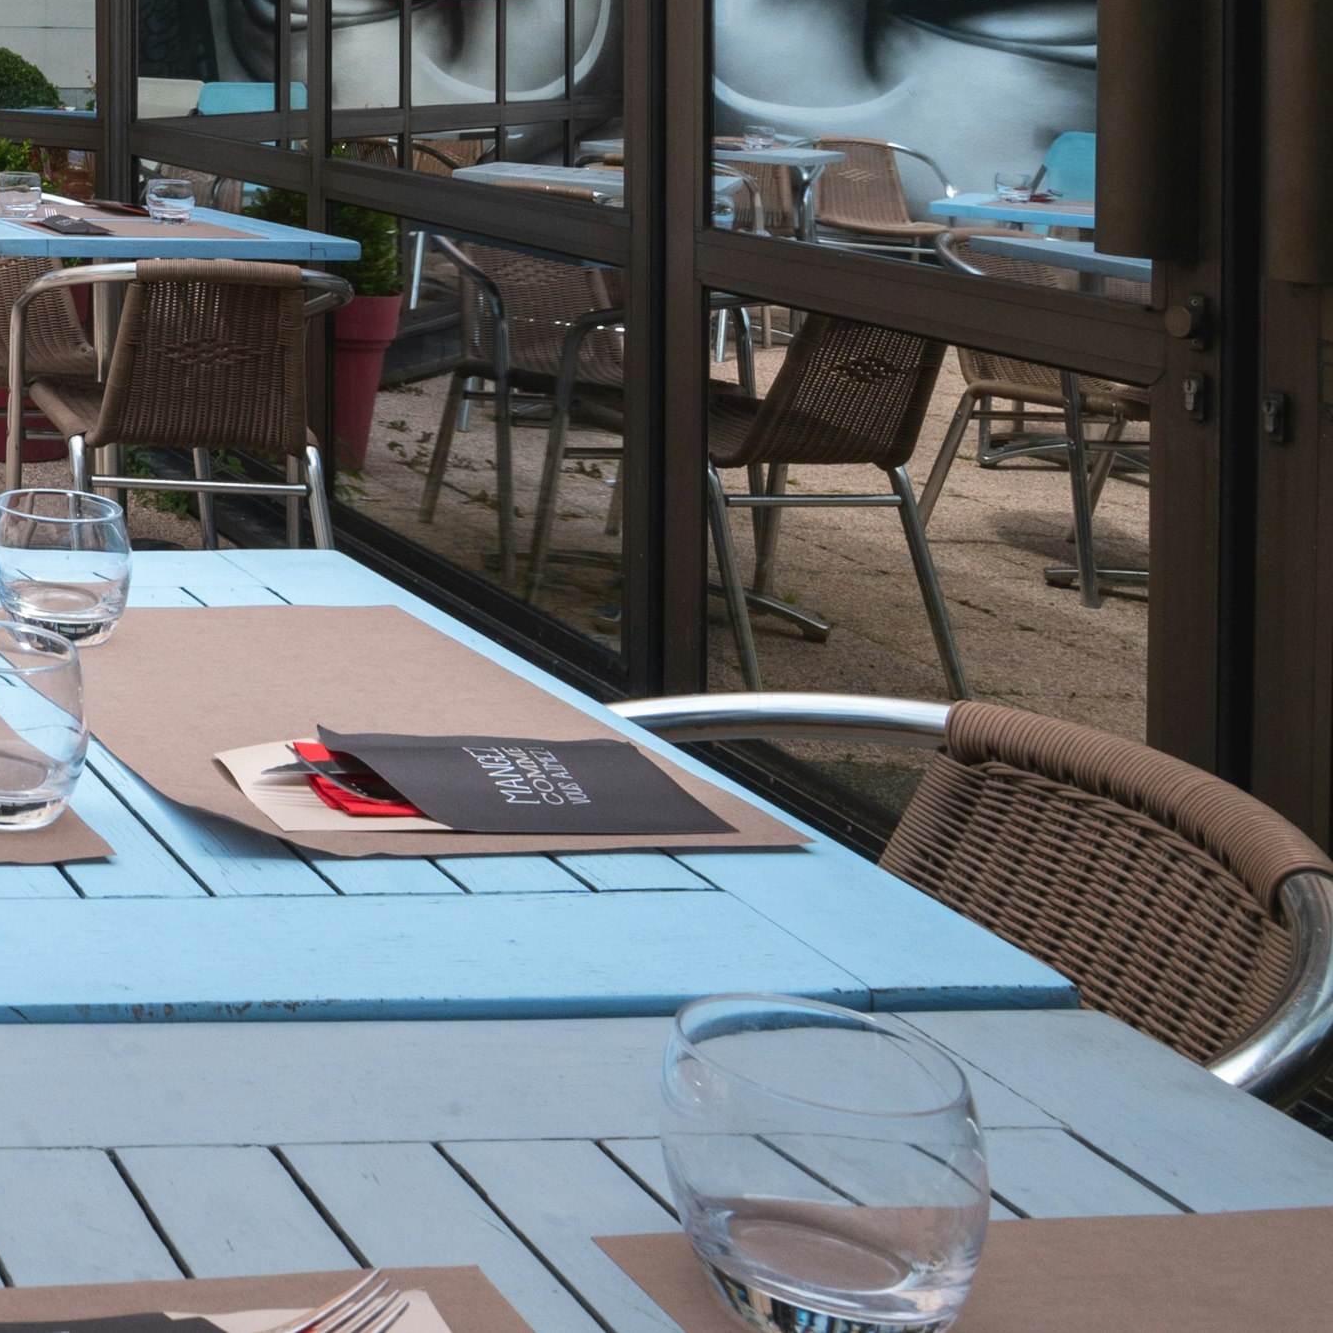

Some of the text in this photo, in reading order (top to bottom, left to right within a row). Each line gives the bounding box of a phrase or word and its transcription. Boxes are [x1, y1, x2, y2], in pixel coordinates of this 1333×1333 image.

[461, 746, 541, 805] MANGEZ
[500, 746, 565, 805] COMME
[556, 782, 592, 805] VOUS
